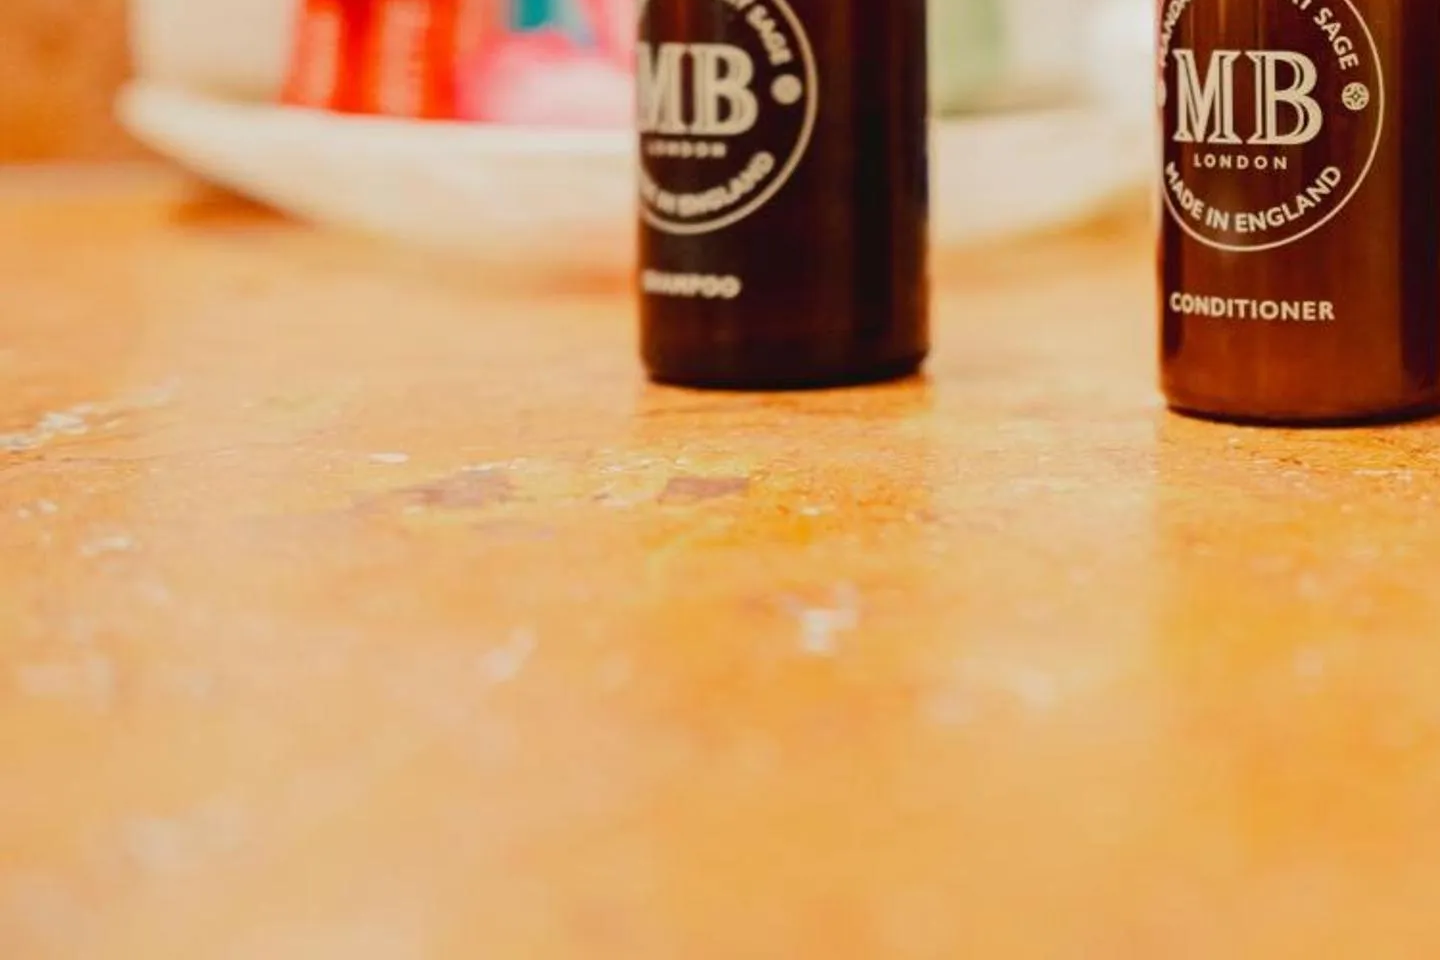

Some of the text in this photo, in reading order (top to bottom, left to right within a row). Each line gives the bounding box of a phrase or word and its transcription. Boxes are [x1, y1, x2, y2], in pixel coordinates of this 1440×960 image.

[745, 5, 793, 65] SAGE
[1313, 7, 1360, 70] SAGE
[637, 41, 759, 136] MB
[1172, 48, 1323, 146] MB
[1193, 152, 1288, 171] LONDON
[1165, 161, 1341, 233] MADE IN ENGLAND
[1170, 292, 1335, 321] CONDITIONER
